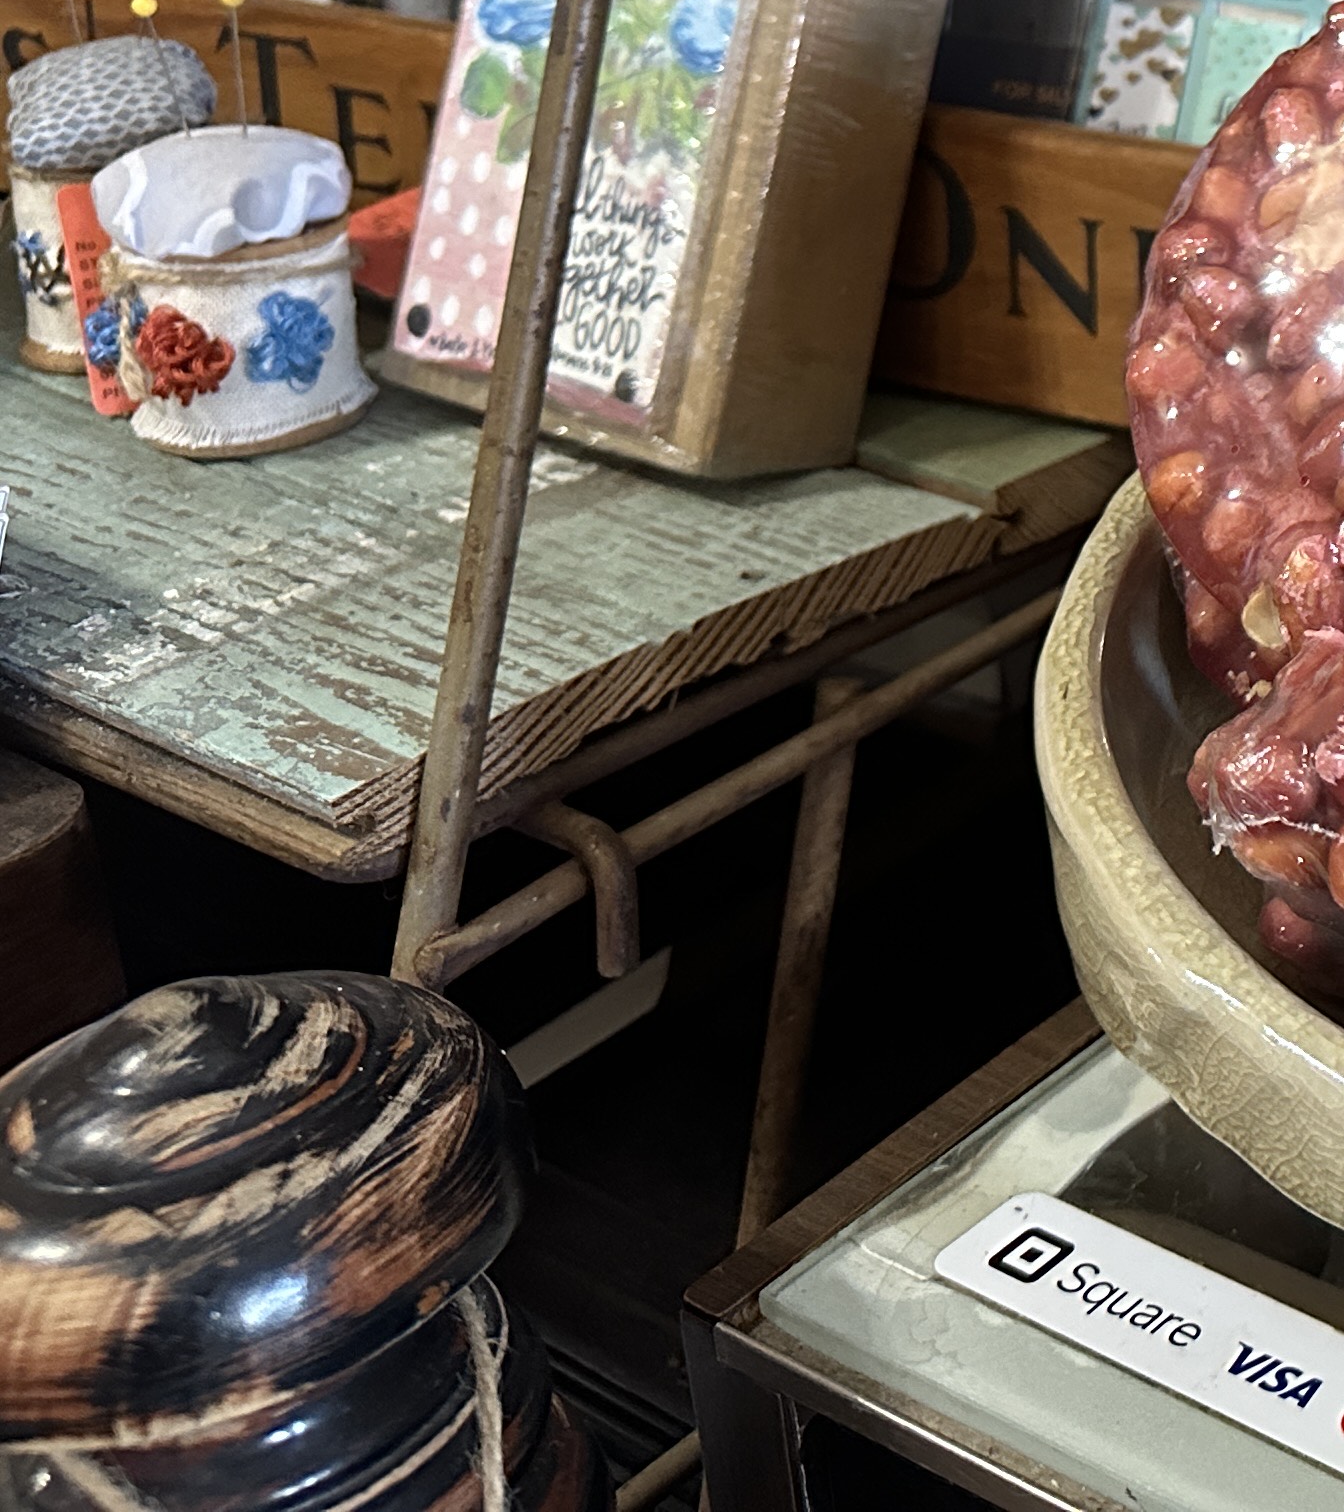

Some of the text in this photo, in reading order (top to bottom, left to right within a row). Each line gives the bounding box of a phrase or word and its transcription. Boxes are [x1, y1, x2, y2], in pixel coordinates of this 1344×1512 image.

[574, 300, 642, 362] GOOD
[1054, 1260, 1323, 1409] Square VISA
